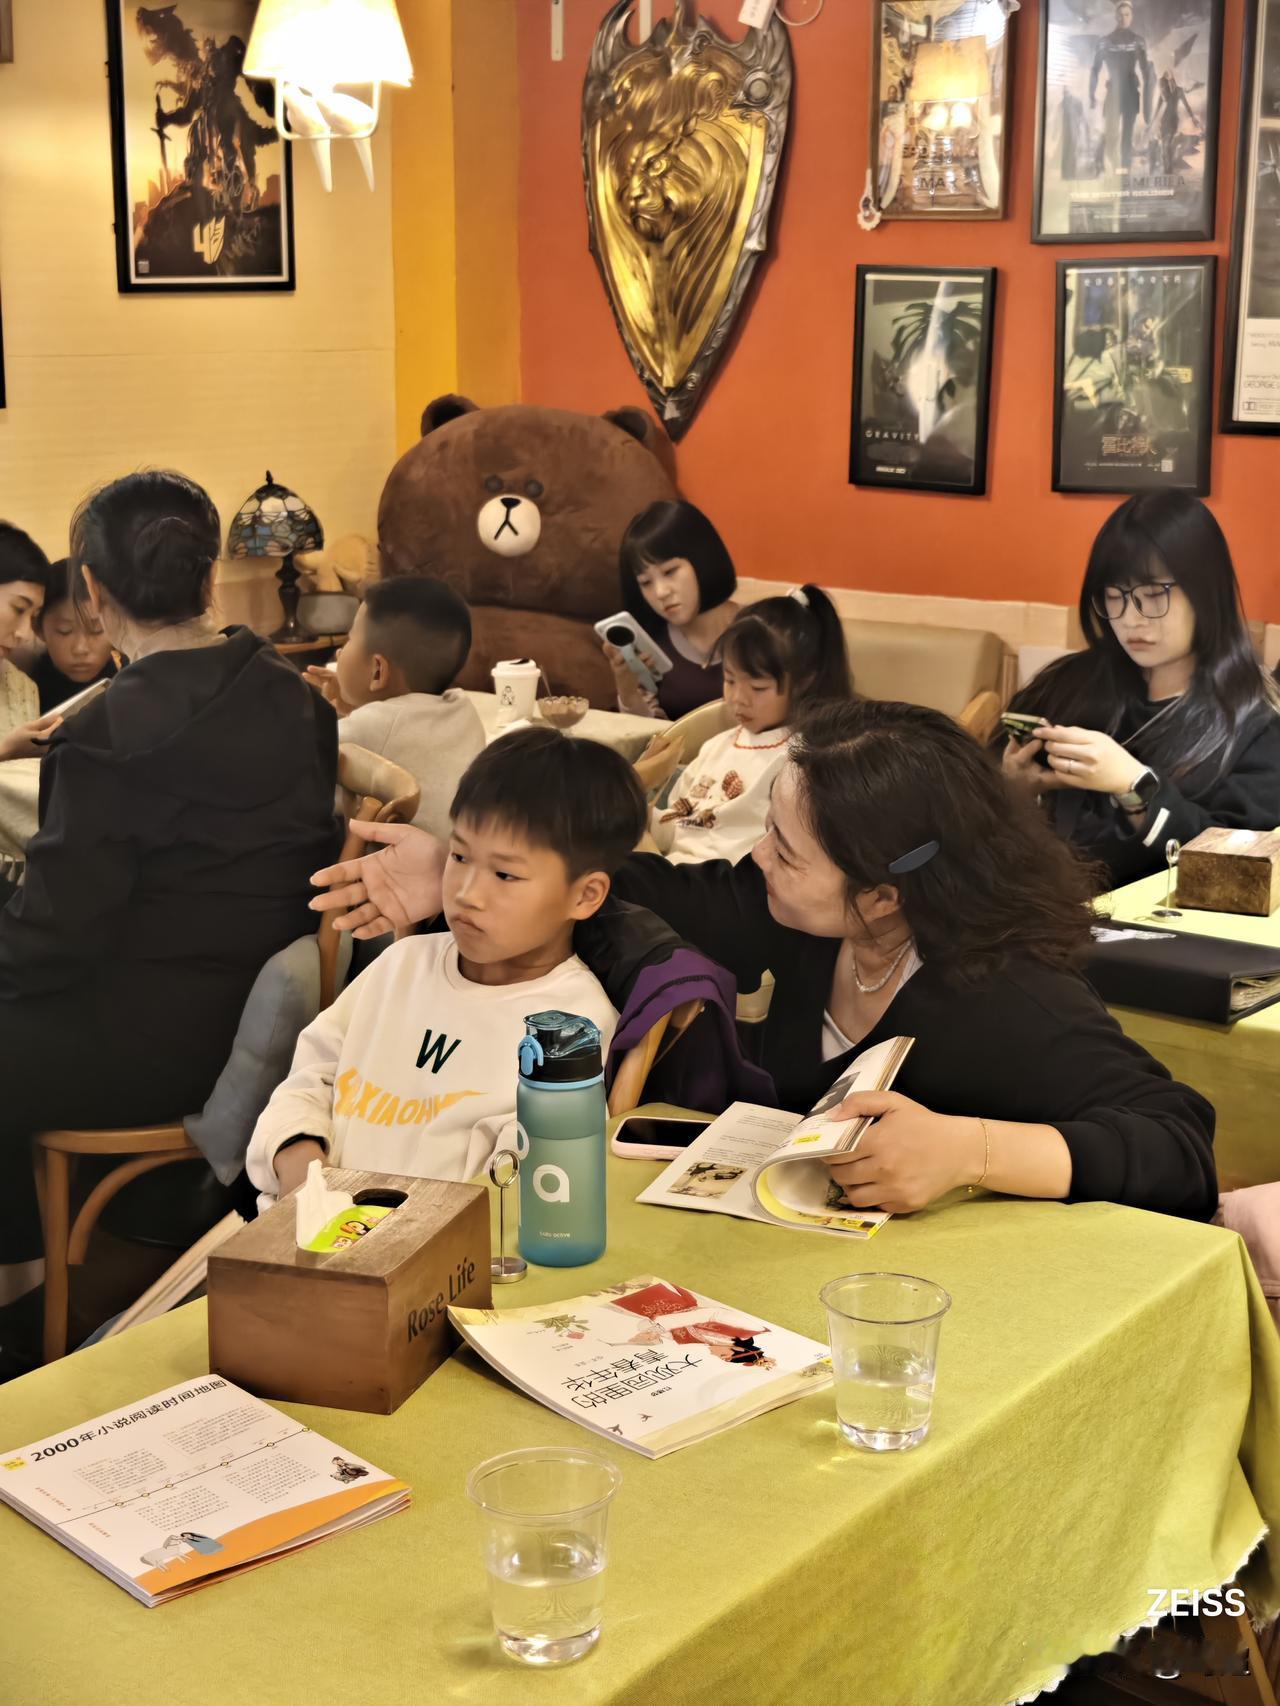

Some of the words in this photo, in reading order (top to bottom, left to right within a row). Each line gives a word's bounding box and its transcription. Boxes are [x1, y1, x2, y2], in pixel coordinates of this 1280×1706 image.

[864, 430, 920, 441] GRAVITY
[414, 1028, 462, 1075] W
[407, 1292, 445, 1343] Rose
[448, 1256, 476, 1303] Life
[561, 1348, 669, 1393] 青春年华
[571, 1353, 704, 1410] 大观园里的
[30, 1379, 228, 1462] 2000年小说阅读时间地图
